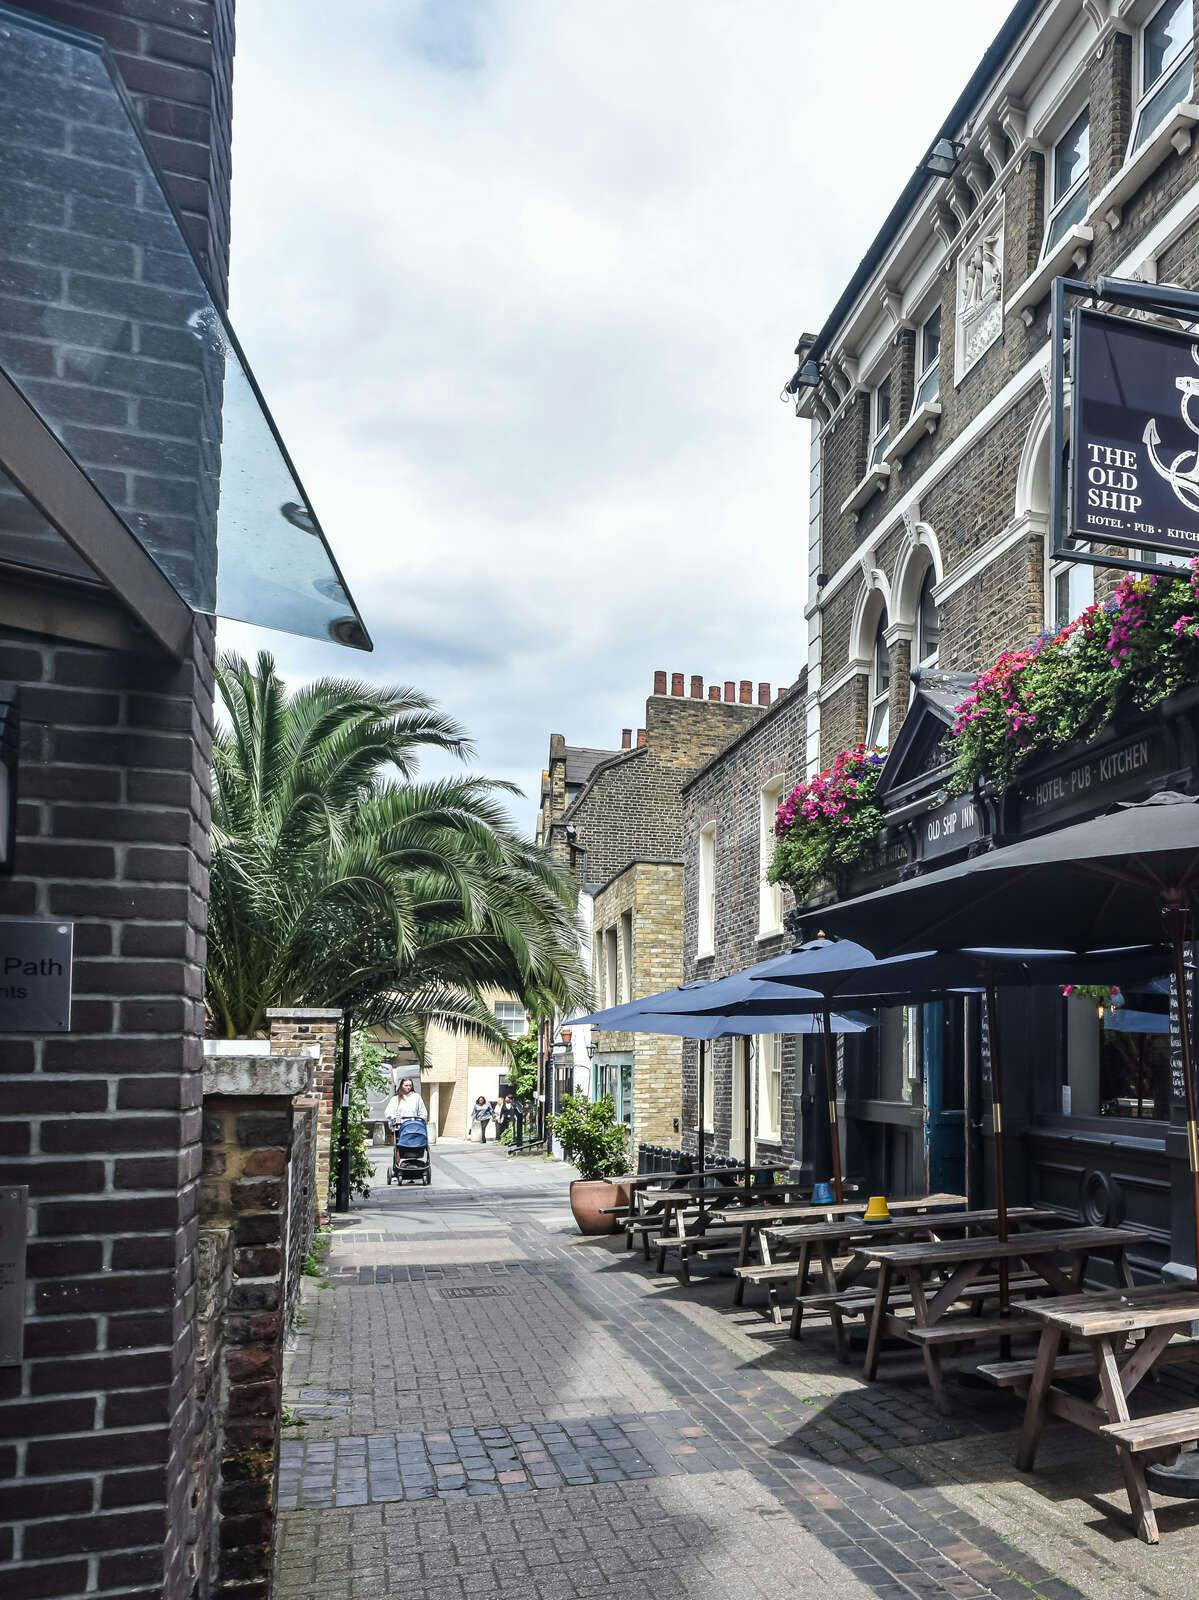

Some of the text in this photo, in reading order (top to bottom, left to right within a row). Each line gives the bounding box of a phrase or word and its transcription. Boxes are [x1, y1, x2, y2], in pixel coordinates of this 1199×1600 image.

[1087, 443, 1138, 470] THE
[1088, 466, 1138, 491] OLD
[1087, 488, 1143, 514] SHIP
[1087, 514, 1124, 529] HOTEL
[1134, 522, 1155, 534] PUB
[1036, 741, 1149, 806] HOTEL PUB KITCHEN
[927, 804, 975, 841] OLD SHIP INN
[3, 957, 63, 977] Path
